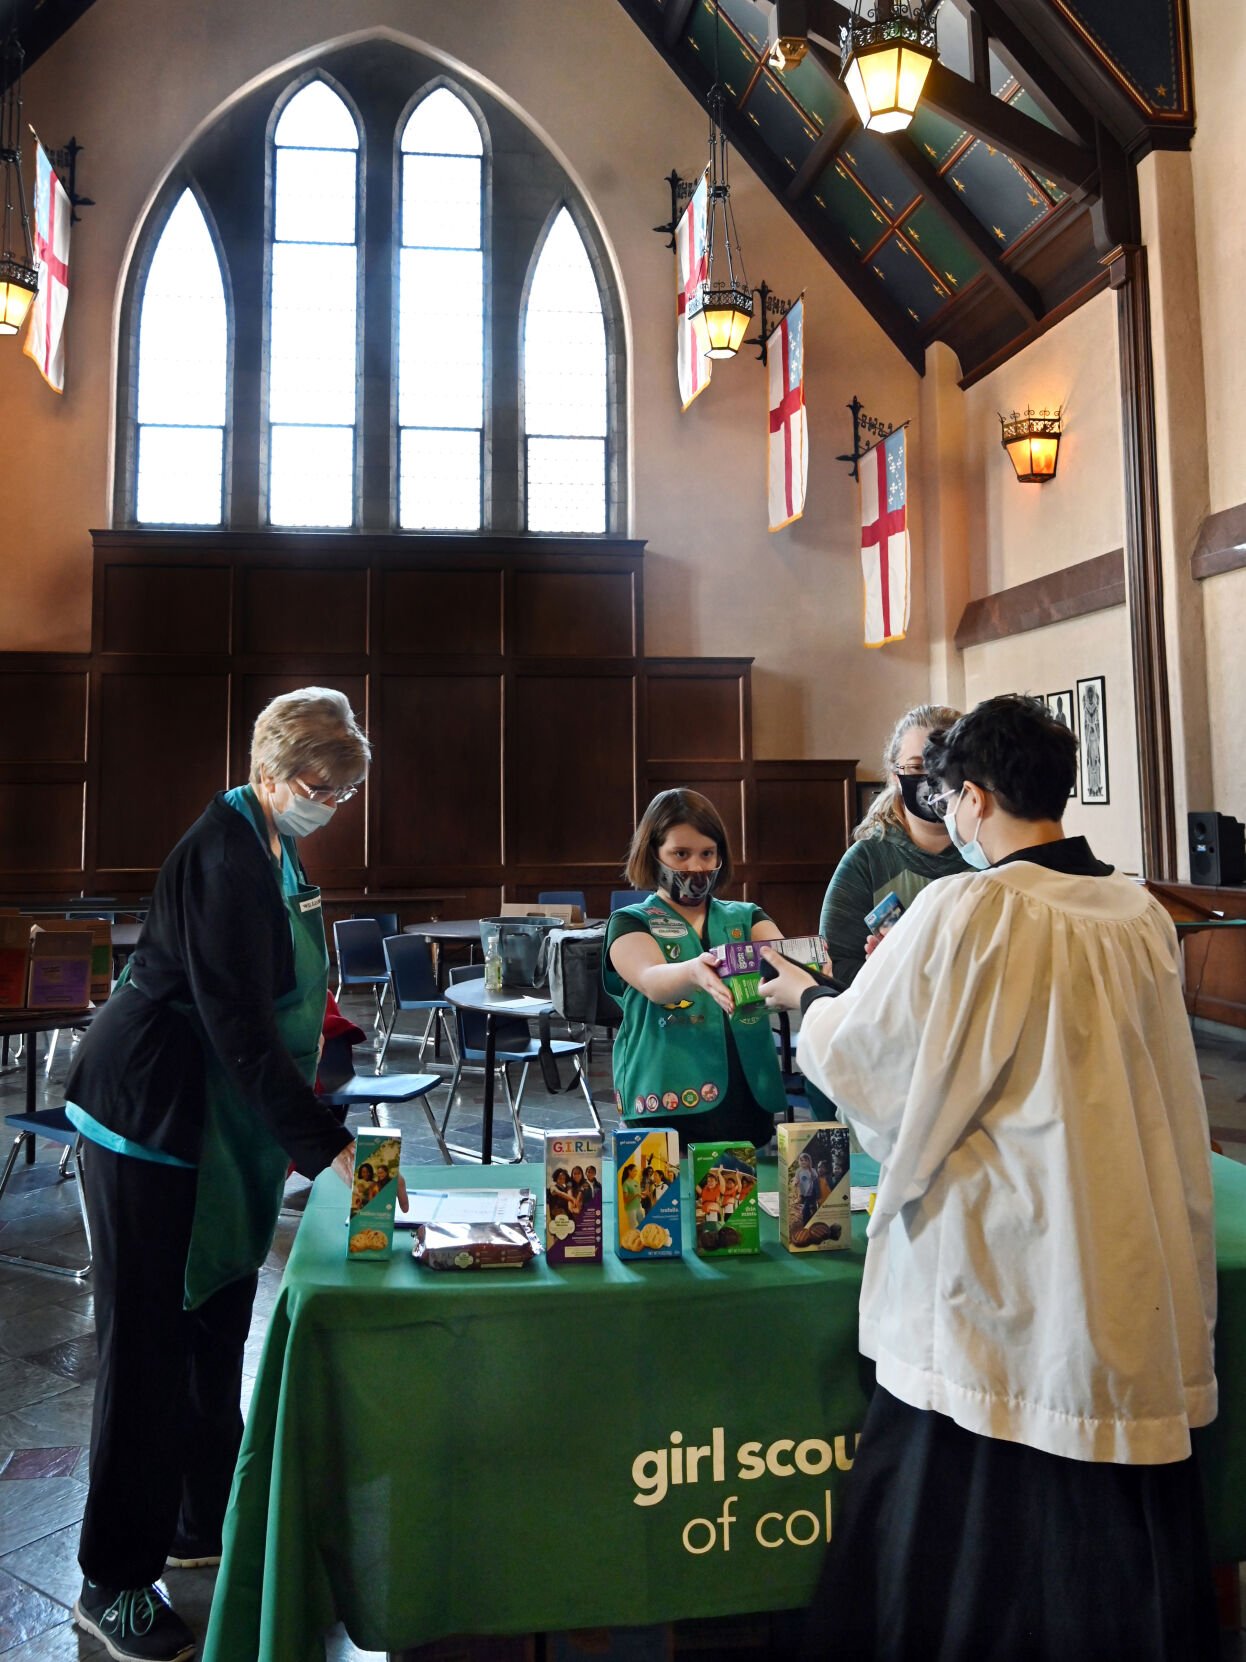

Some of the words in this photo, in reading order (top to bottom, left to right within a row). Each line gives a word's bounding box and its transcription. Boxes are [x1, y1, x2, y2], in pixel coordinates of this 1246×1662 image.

[631, 1426, 726, 1508] girl
[736, 1431, 863, 1481] scou
[681, 1495, 739, 1555] of
[754, 1488, 833, 1549] col
